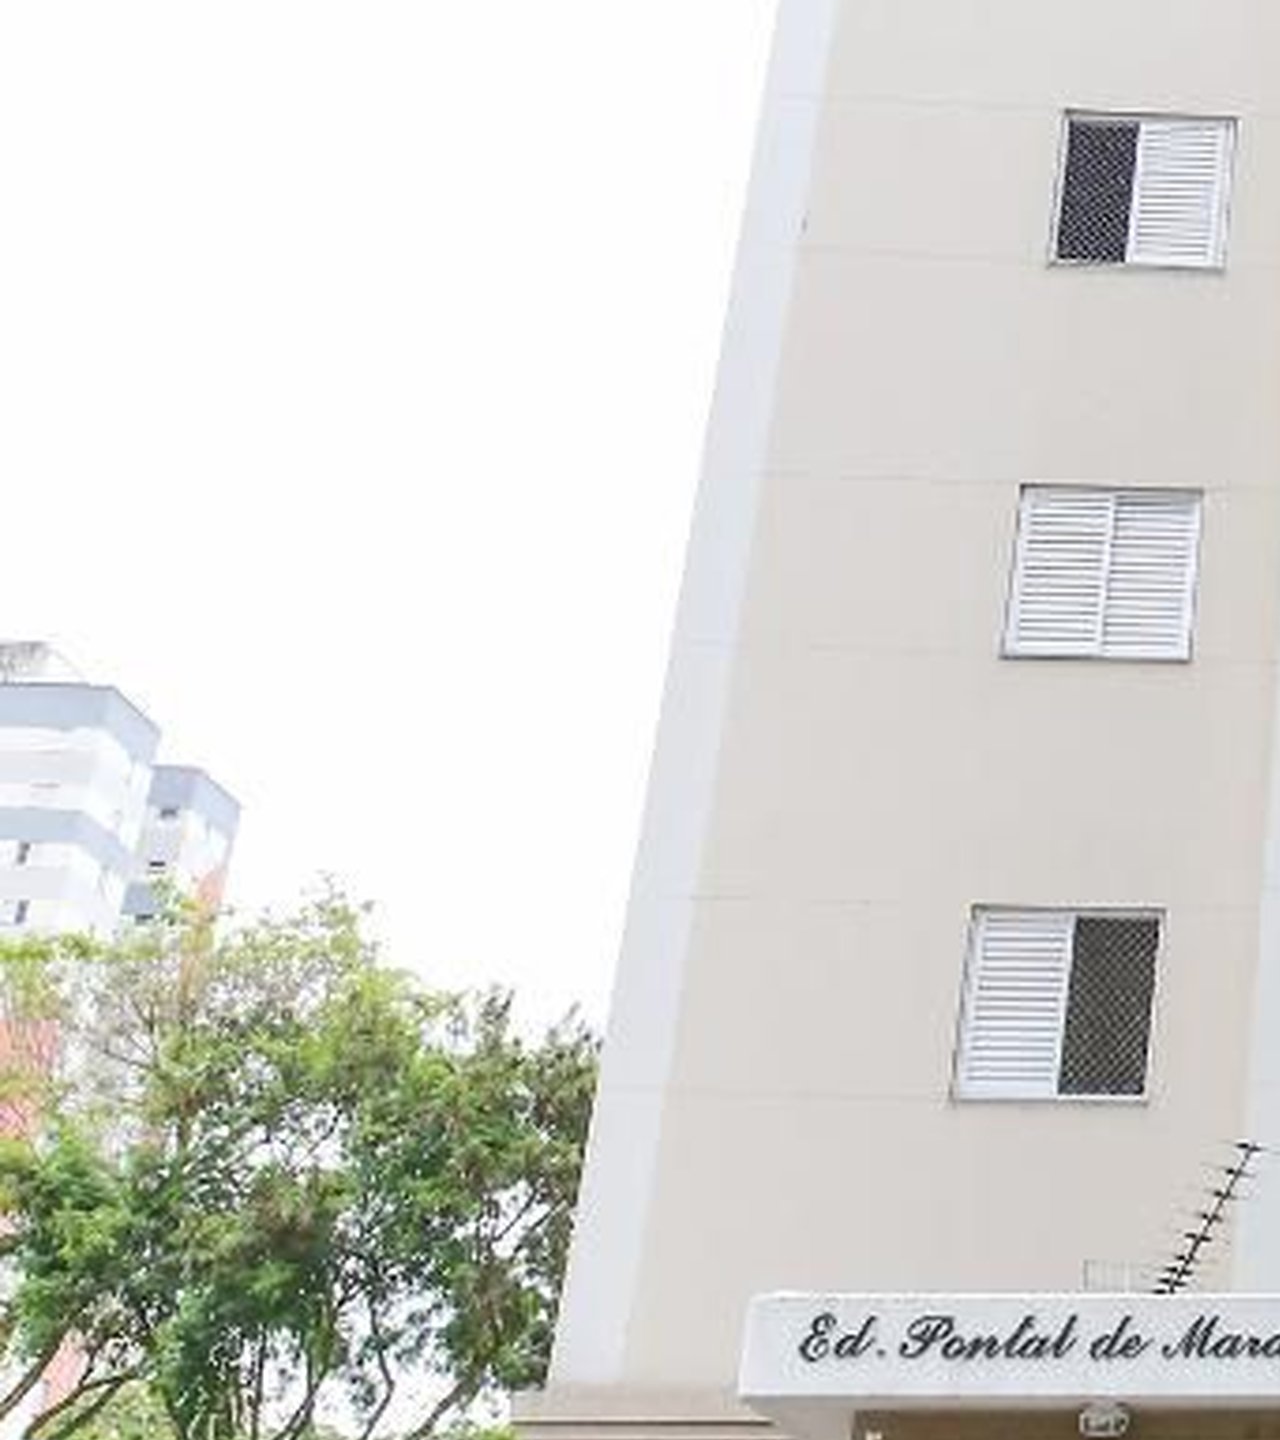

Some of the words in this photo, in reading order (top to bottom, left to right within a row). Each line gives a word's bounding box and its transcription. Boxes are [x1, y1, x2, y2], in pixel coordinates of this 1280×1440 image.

[800, 1313, 886, 1362] Ed.
[899, 1315, 1078, 1360] Pontal
[1089, 1315, 1154, 1360] de
